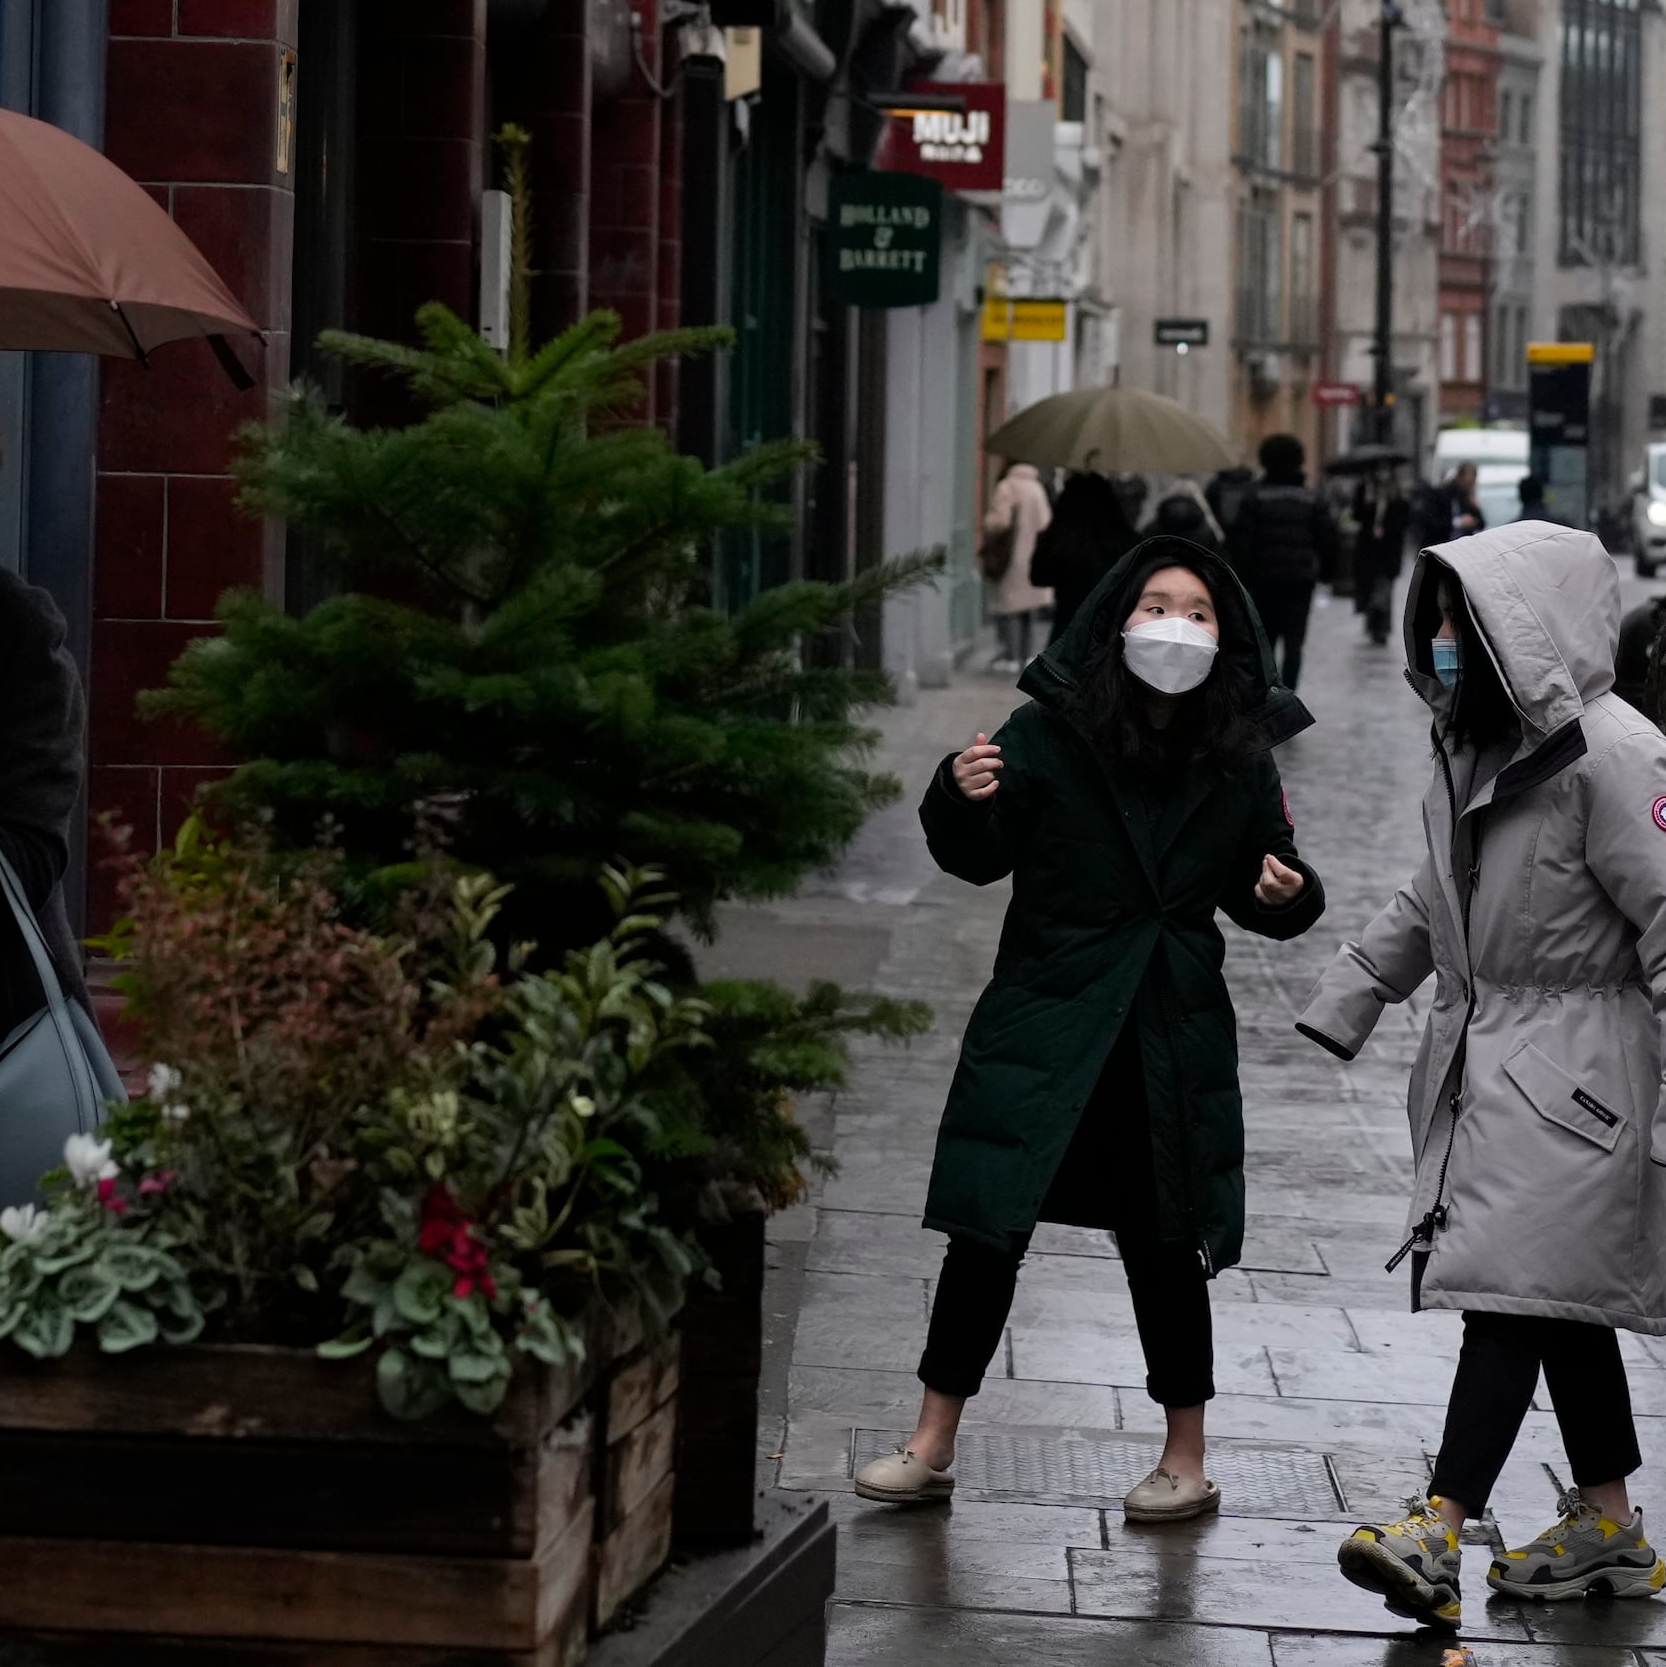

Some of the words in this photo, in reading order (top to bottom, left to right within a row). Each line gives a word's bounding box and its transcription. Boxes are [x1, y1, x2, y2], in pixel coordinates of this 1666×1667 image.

[913, 111, 989, 145] MUJI
[840, 204, 931, 229] HOLLAND
[839, 248, 928, 274] BARRETT
